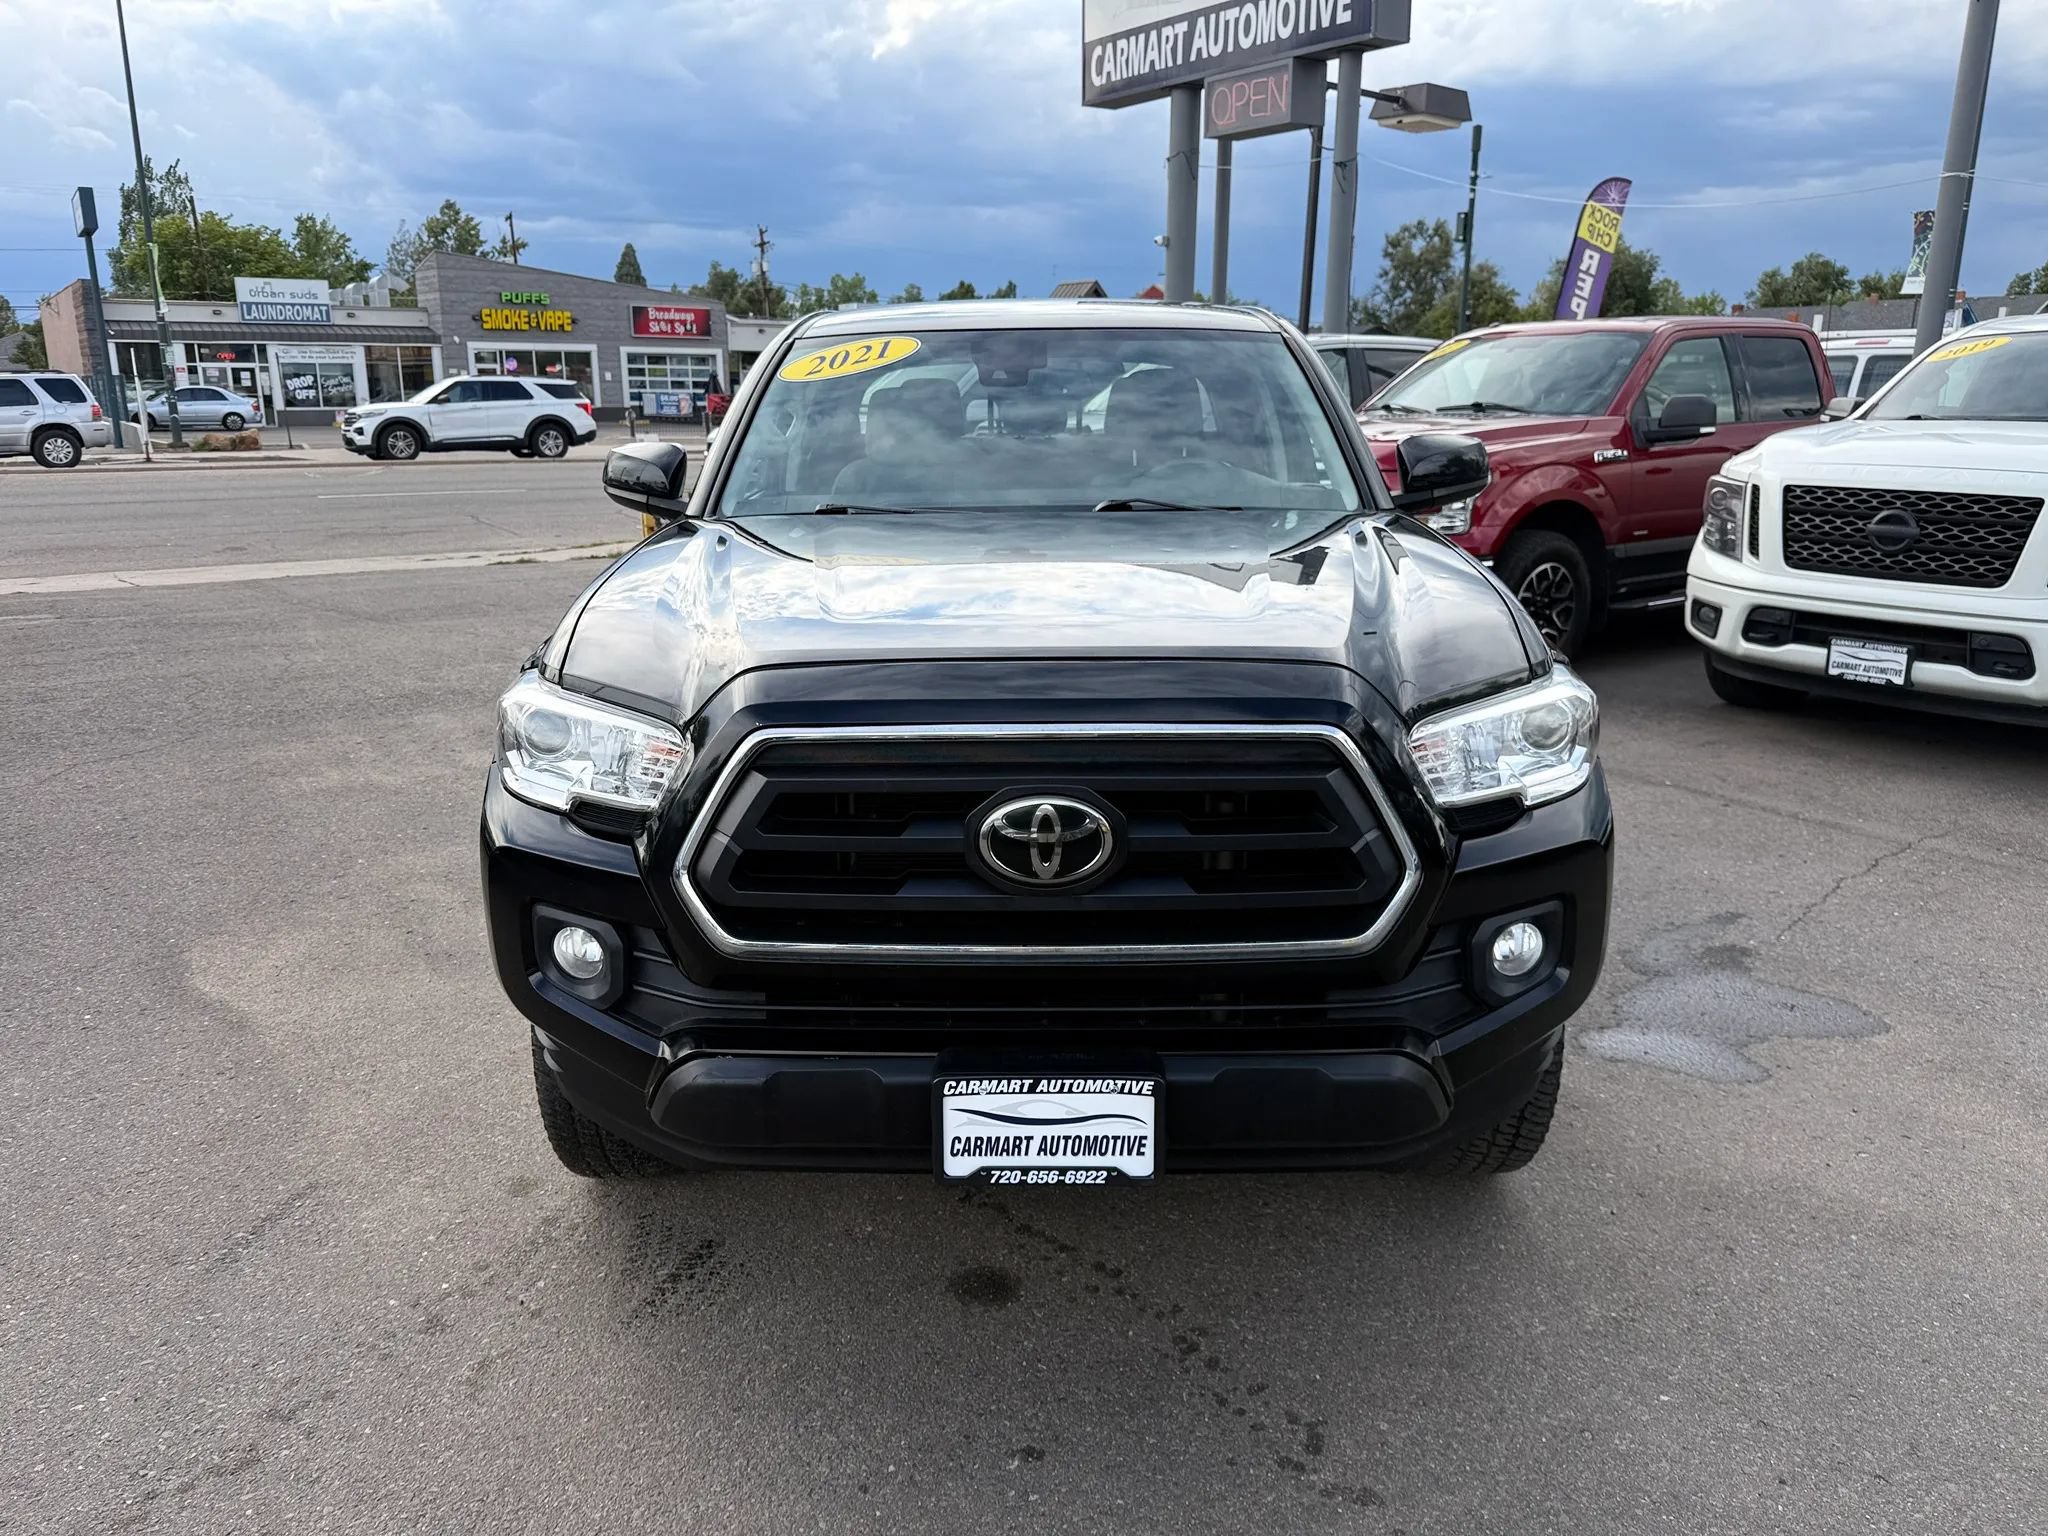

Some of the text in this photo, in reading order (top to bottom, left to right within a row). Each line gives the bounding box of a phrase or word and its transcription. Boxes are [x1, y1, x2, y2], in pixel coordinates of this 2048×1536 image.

[1091, 0, 1352, 87] CARMART AUTOMOTIVE
[1211, 73, 1289, 126] OPEN
[249, 286, 318, 300] urban suds
[501, 292, 550, 305] PUFFS
[243, 303, 328, 321] LAUNDROMAT
[481, 308, 529, 330] SMOKE
[538, 310, 572, 331] VAPE
[216, 352, 236, 360] OPEN
[804, 340, 892, 377] 2021
[285, 375, 314, 391] DROP
[295, 389, 316, 400] OFF
[1831, 661, 1904, 678] CARMART AUTOMOTIVE
[943, 1079, 1154, 1095] CARMART AUTOMOTIVE
[950, 1135, 1147, 1157] CARMART AUTOMOTIVE
[990, 1170, 1107, 1184] 720-656-6922
